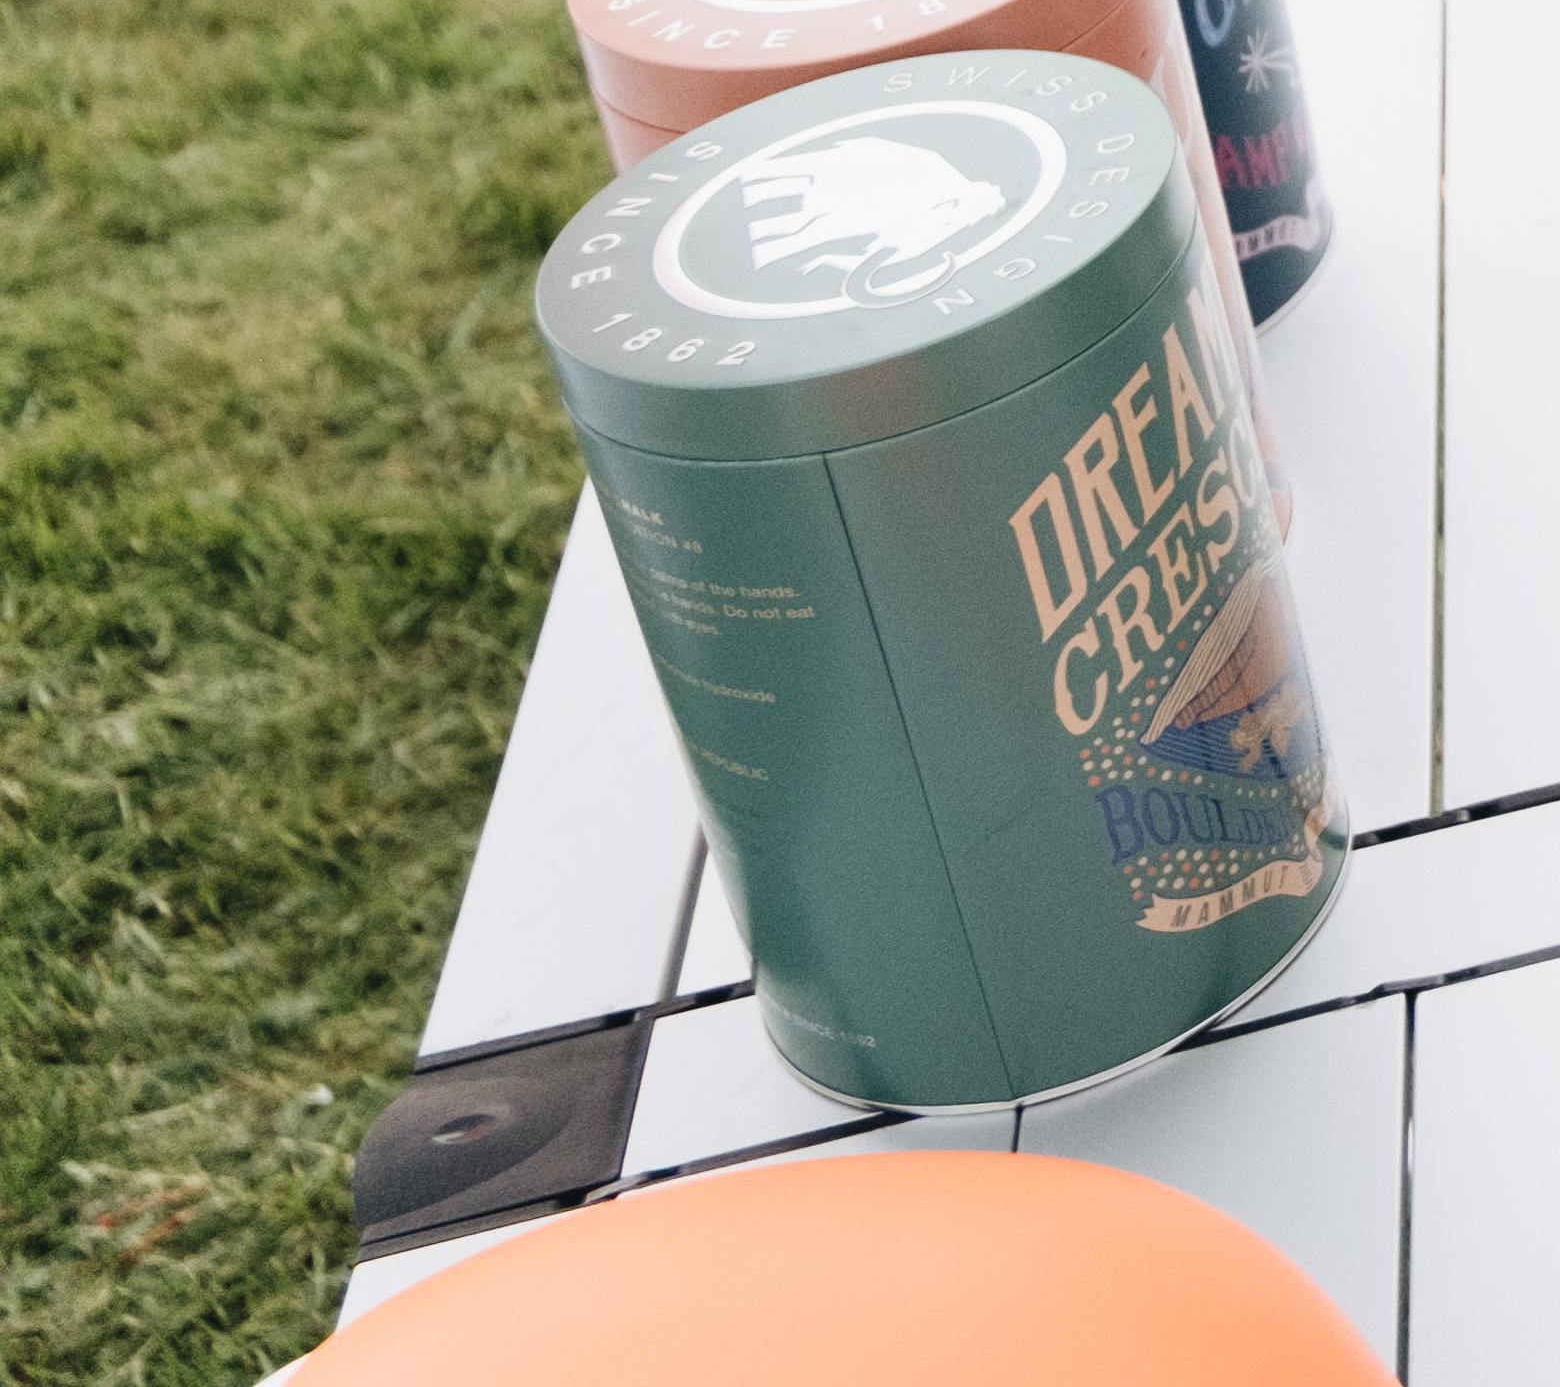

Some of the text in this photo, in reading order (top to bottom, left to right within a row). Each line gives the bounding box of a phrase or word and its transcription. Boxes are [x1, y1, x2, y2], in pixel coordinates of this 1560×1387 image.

[571, 138, 758, 367] SINCE 1862
[884, 65, 1137, 315] SWISS DESIGN
[1008, 287, 1242, 645] DREAM
[722, 603, 748, 620] Do
[751, 605, 782, 620] not
[786, 604, 816, 620] eat
[738, 583, 800, 600] hands.
[1170, 864, 1291, 930] MAMMUT
